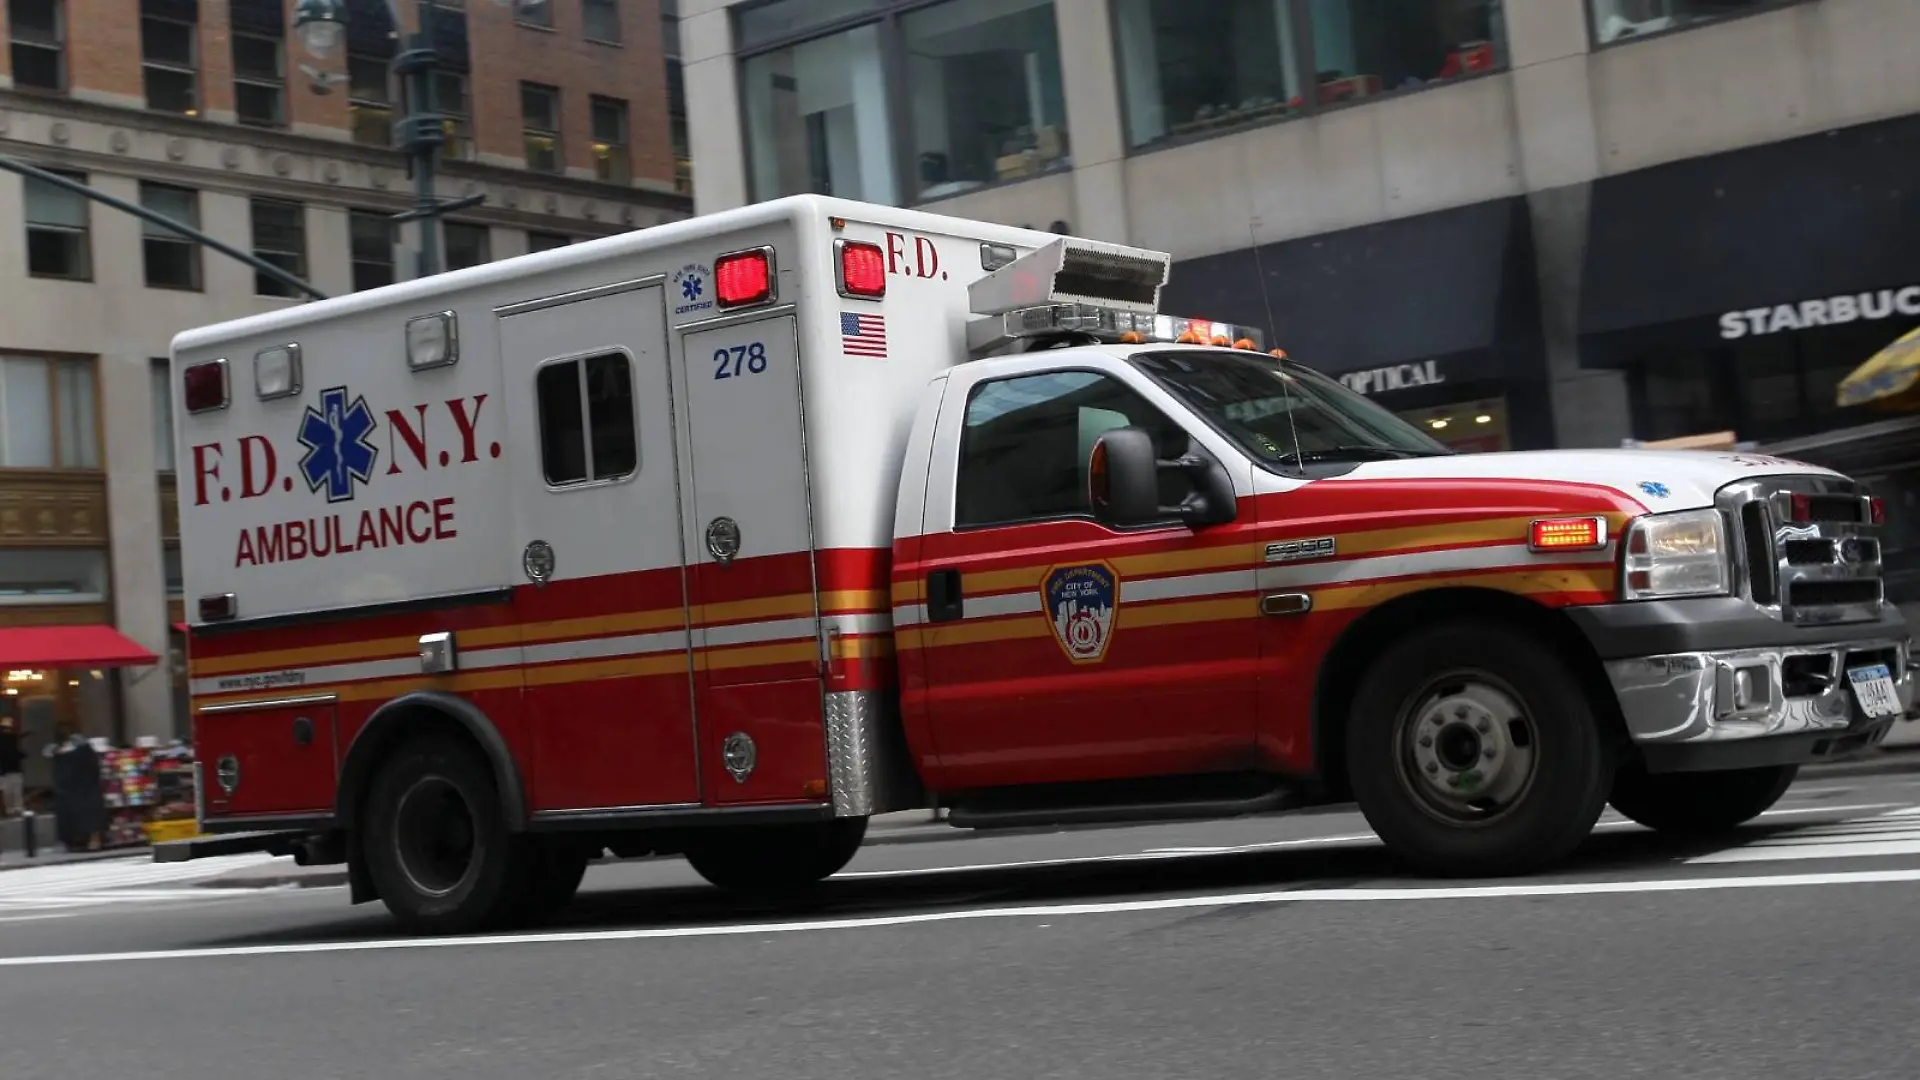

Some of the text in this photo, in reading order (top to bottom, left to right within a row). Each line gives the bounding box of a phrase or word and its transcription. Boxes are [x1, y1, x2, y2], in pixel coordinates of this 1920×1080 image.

[886, 232, 948, 281] F.D.
[675, 301, 712, 314] CERTIFIED
[1719, 286, 1920, 339] STARBUC
[713, 342, 767, 380] 278
[192, 394, 501, 505] F.D. N.Y.
[235, 498, 457, 568] AMBULANCE
[1061, 588, 1098, 598] NEW YORK
[1064, 569, 1110, 588] DEPARTMENT
[1066, 581, 1094, 590] CITY OF
